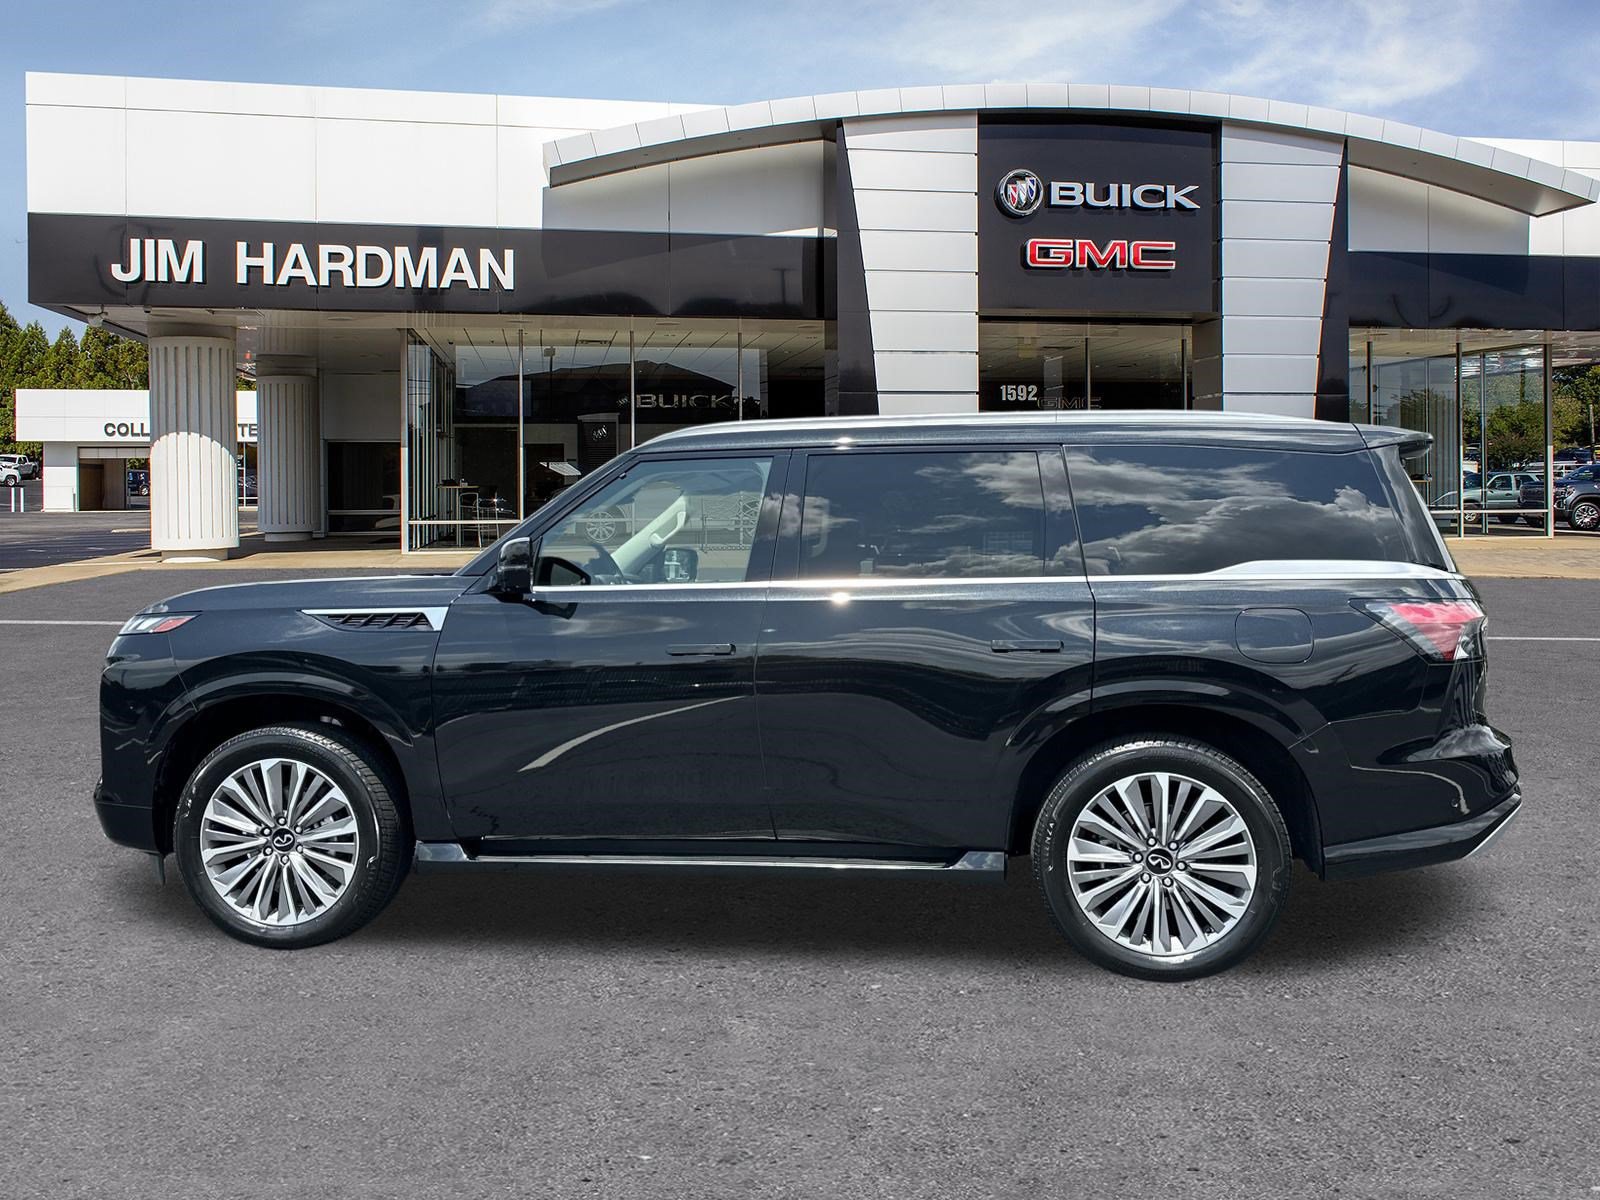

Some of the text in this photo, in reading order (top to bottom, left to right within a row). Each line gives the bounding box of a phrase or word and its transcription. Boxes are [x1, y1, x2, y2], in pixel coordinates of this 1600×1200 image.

[1050, 181, 1200, 208] BUICK
[111, 238, 515, 290] JIM HARDMAN
[1026, 238, 1176, 269] GMC
[635, 394, 731, 408] BUICK
[1000, 384, 1038, 401] 1592
